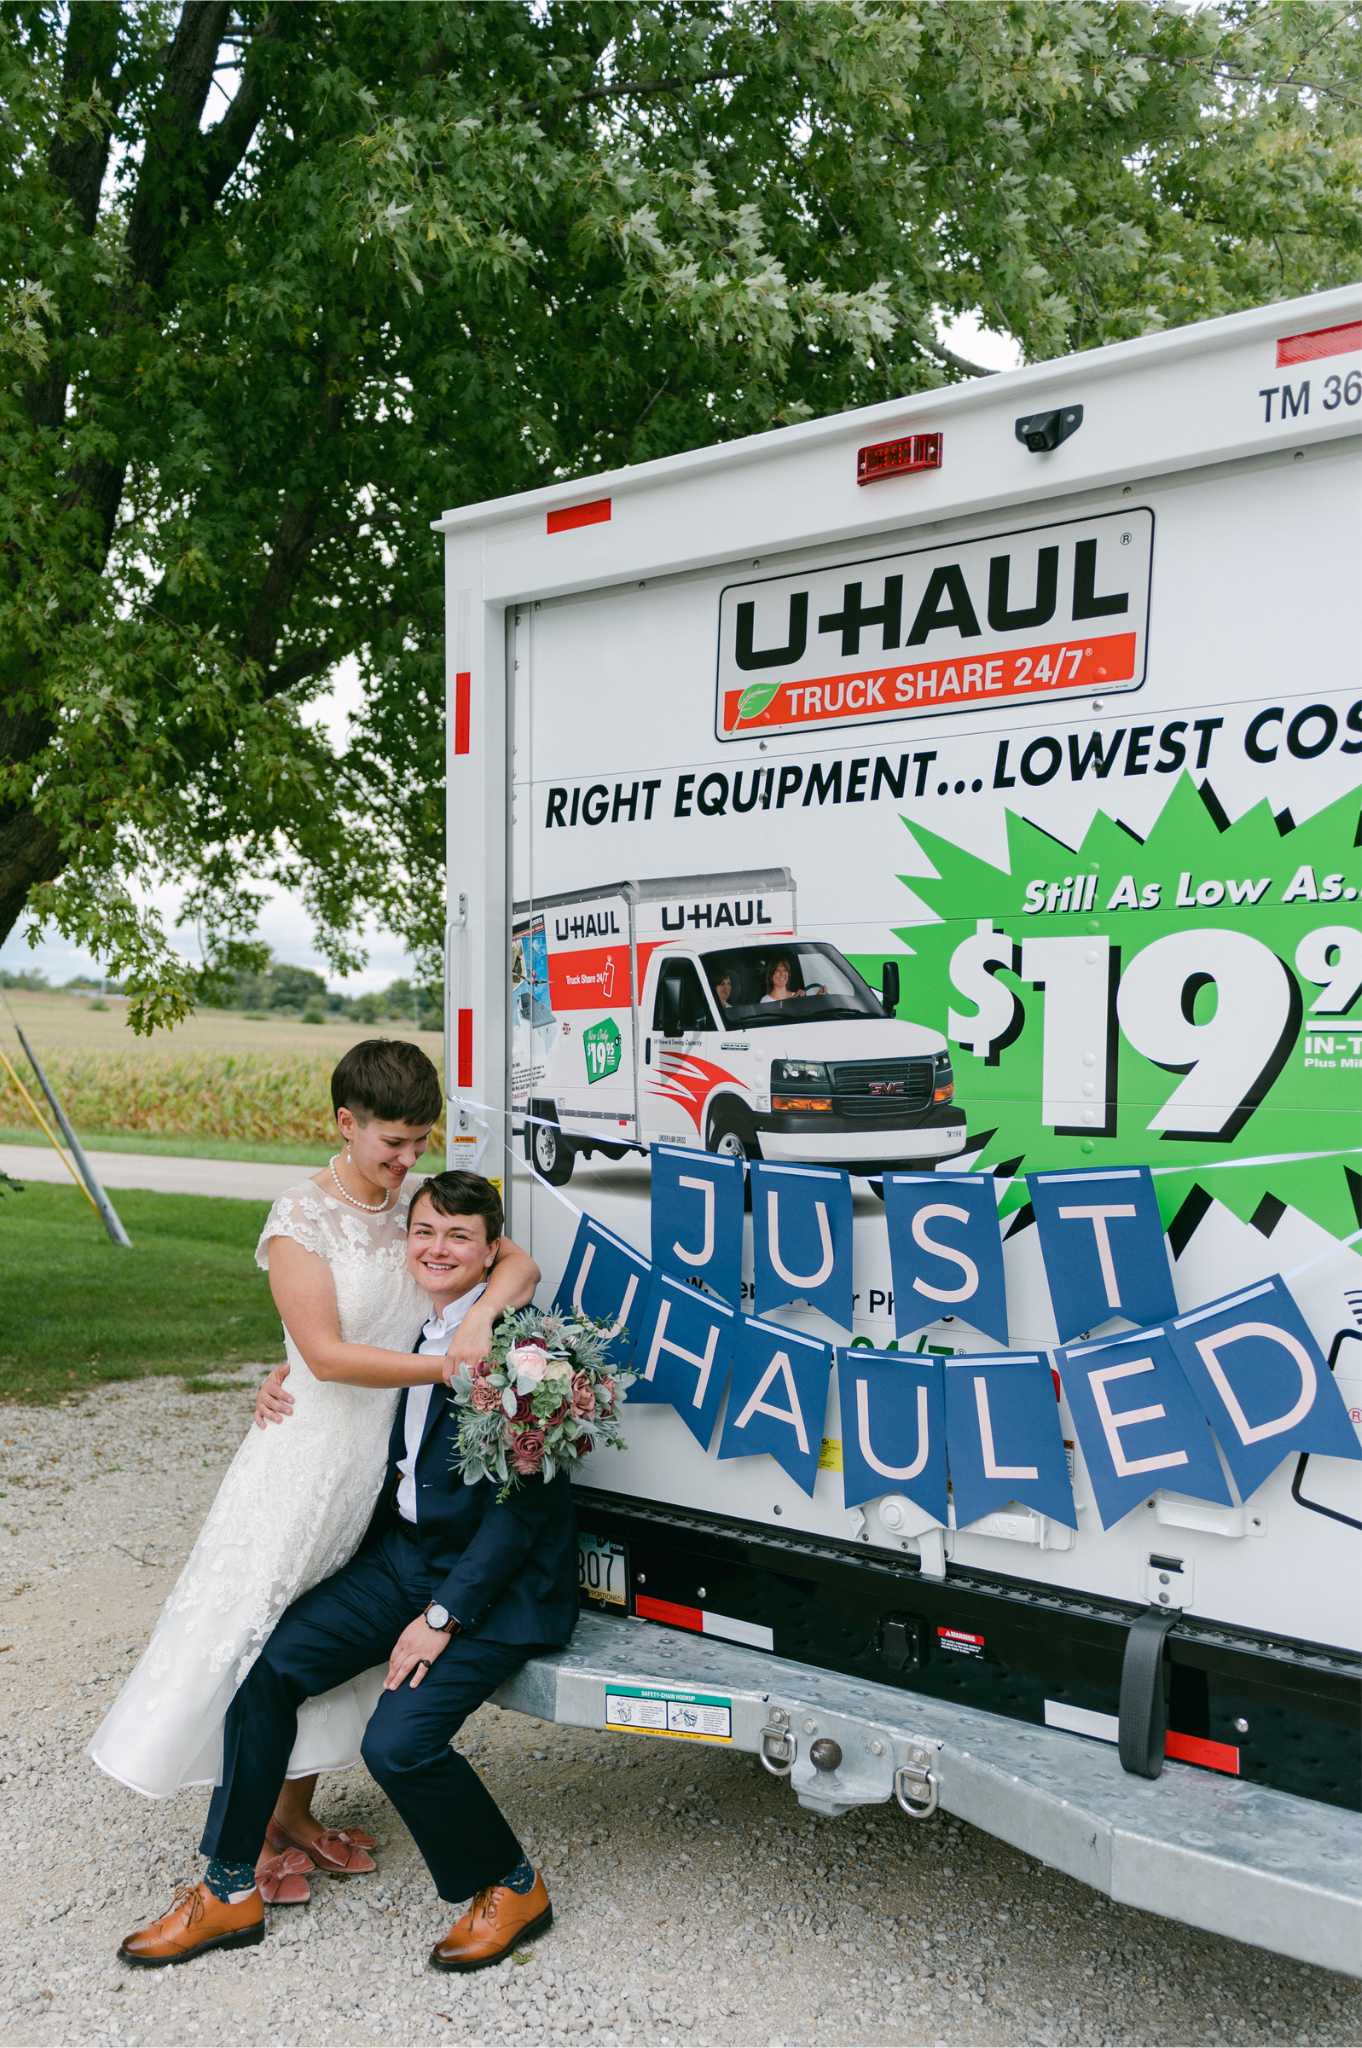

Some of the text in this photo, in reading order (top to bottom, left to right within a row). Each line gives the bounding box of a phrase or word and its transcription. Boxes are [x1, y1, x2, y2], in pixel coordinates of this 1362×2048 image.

[1259, 380, 1310, 423] TM
[734, 538, 1129, 671] U-HAUL
[786, 676, 886, 717] TRUCK
[895, 659, 1004, 700] SHARE
[545, 779, 662, 829] RIGHT
[1021, 873, 1098, 914] Still
[1106, 875, 1162, 909] As
[1175, 872, 1272, 907] Low
[555, 910, 620, 941] U-HAUL
[662, 899, 773, 931] U-HAUL
[1304, 1058, 1336, 1068] Plus
[672, 1175, 1138, 1308] JUST
